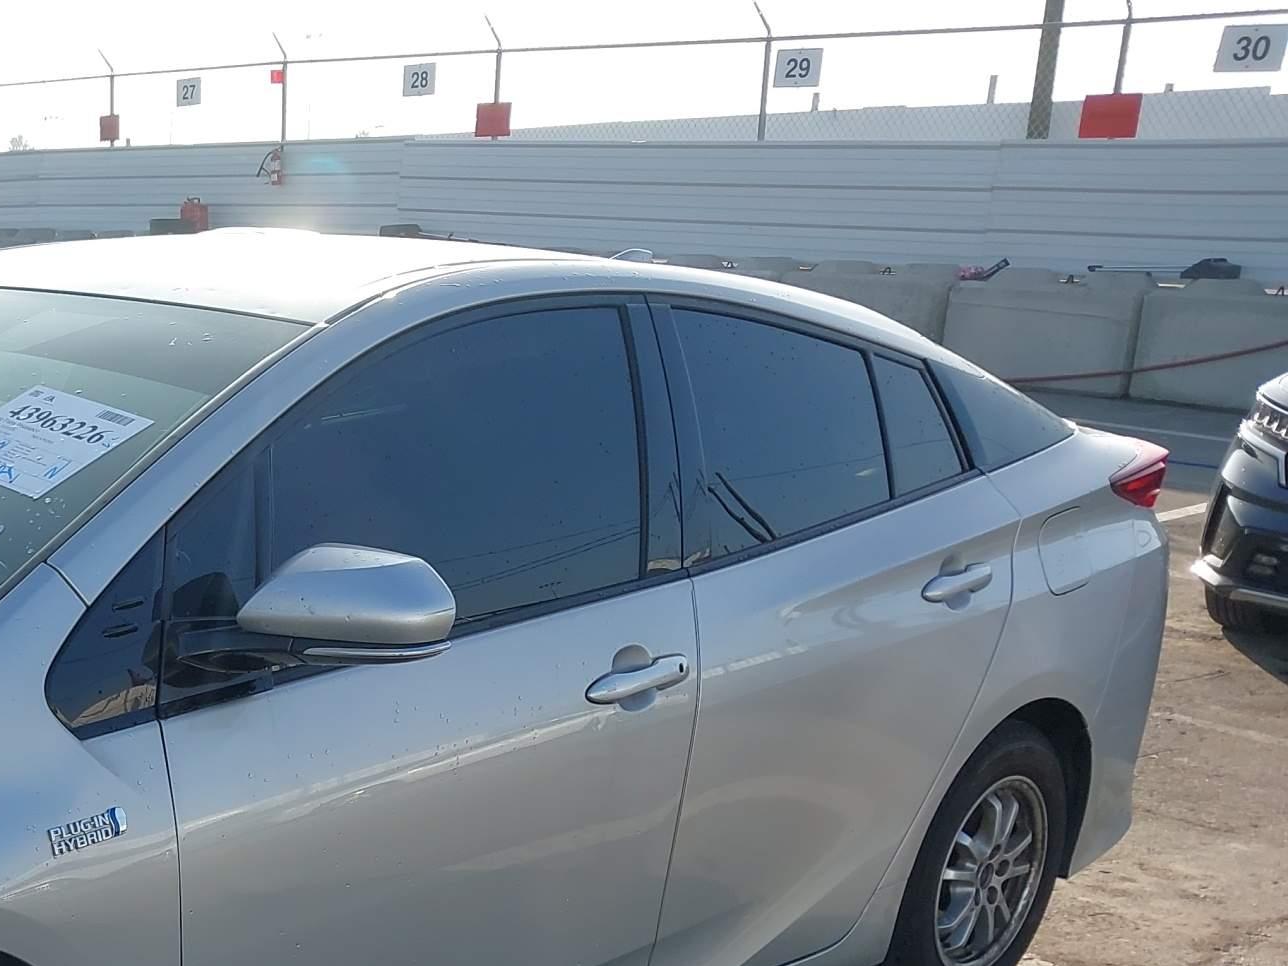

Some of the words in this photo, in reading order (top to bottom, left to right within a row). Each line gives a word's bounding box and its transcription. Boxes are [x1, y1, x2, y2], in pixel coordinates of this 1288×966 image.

[1232, 36, 1271, 61] 30
[411, 71, 429, 88] 28
[785, 58, 811, 78] 29
[182, 85, 196, 100] 27
[9, 405, 114, 444] 43963226
[49, 812, 110, 841] PLUG-IN
[53, 827, 113, 856] HYBRID
